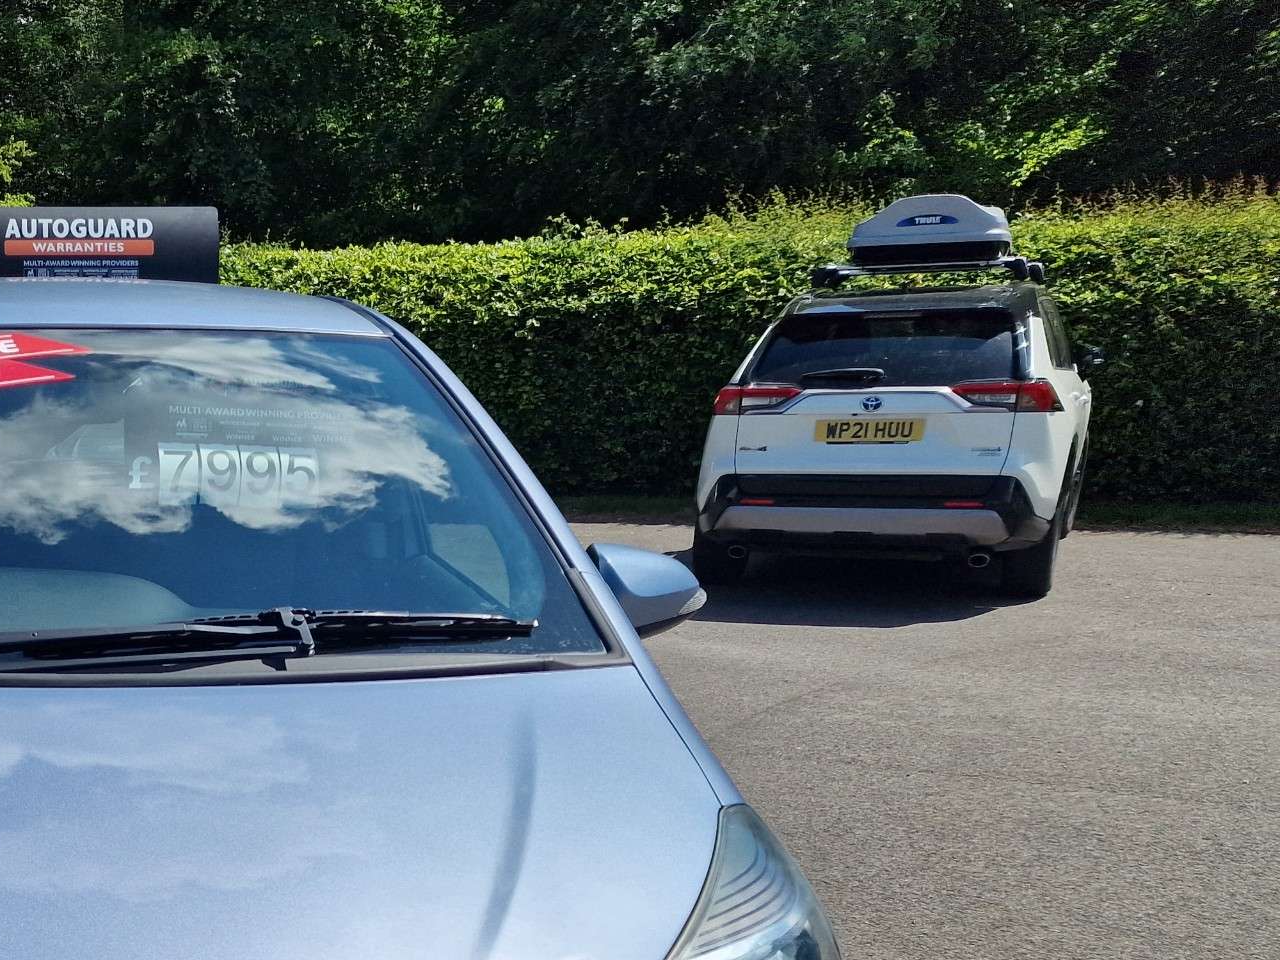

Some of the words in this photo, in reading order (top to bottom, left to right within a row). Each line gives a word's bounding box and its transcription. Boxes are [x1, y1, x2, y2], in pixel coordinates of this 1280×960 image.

[915, 215, 942, 224] THULE
[5, 218, 154, 239] AUTOGUARD
[32, 242, 125, 254] WARRANTIES
[70, 259, 101, 267] WINNING
[102, 259, 139, 267] PROVIDERS
[826, 422, 869, 439] WP21
[874, 421, 913, 438] HUU
